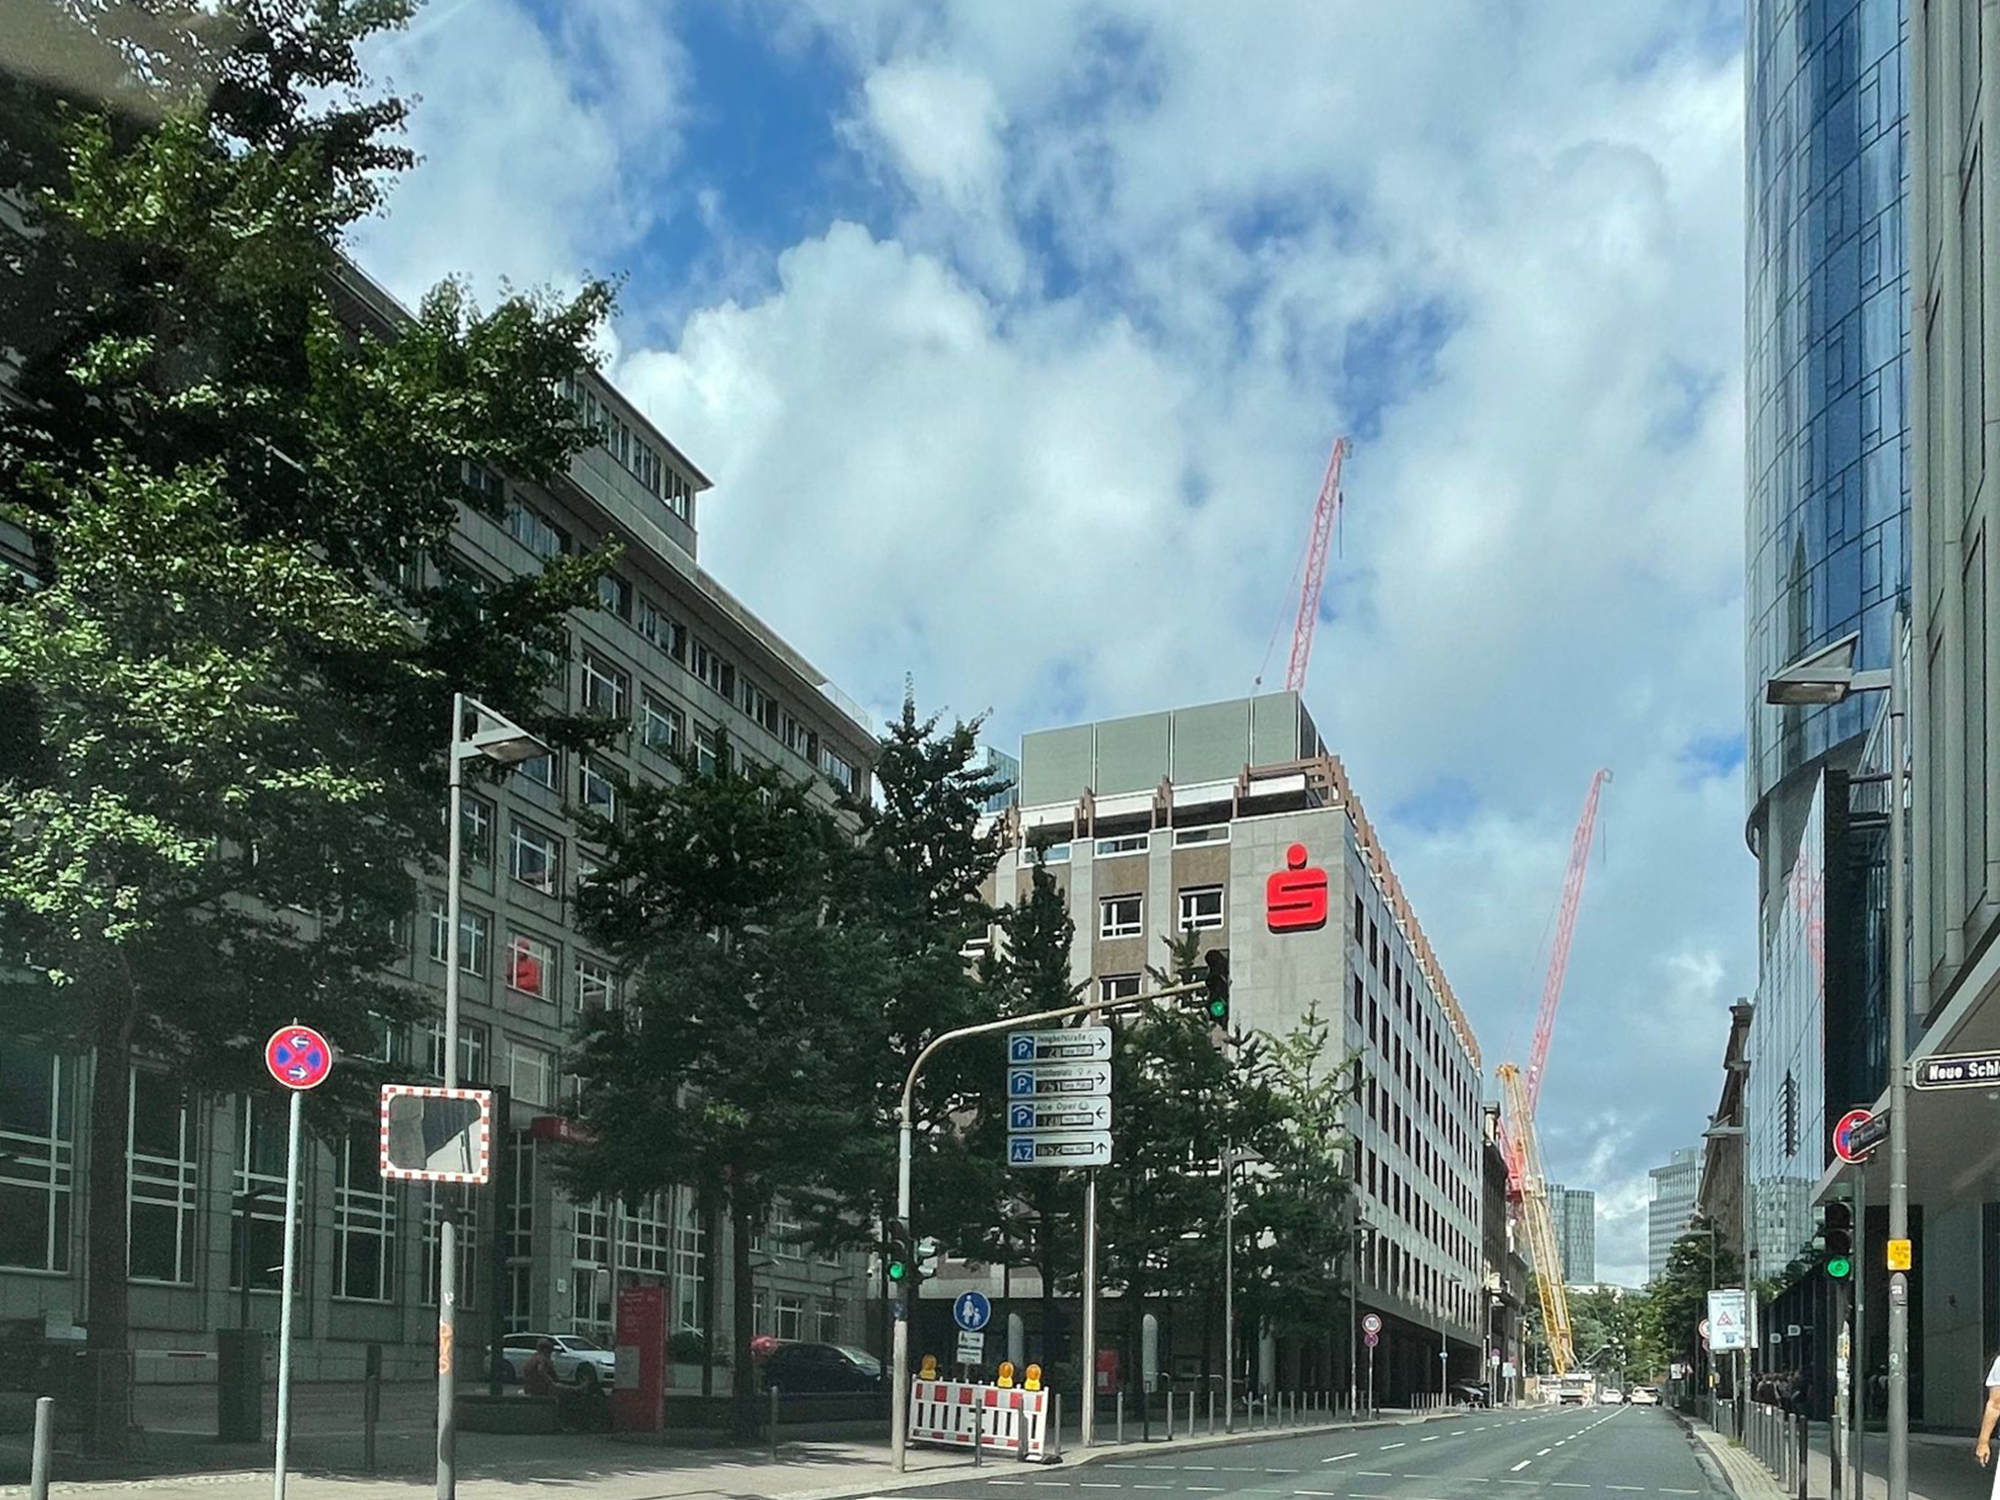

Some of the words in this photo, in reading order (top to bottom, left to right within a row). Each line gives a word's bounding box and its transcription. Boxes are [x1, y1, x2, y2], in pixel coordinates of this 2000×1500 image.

[1929, 1064, 1963, 1080] Neue
[1968, 1060, 2000, 1078] Schl
[1056, 1101, 1077, 1111] Oper
